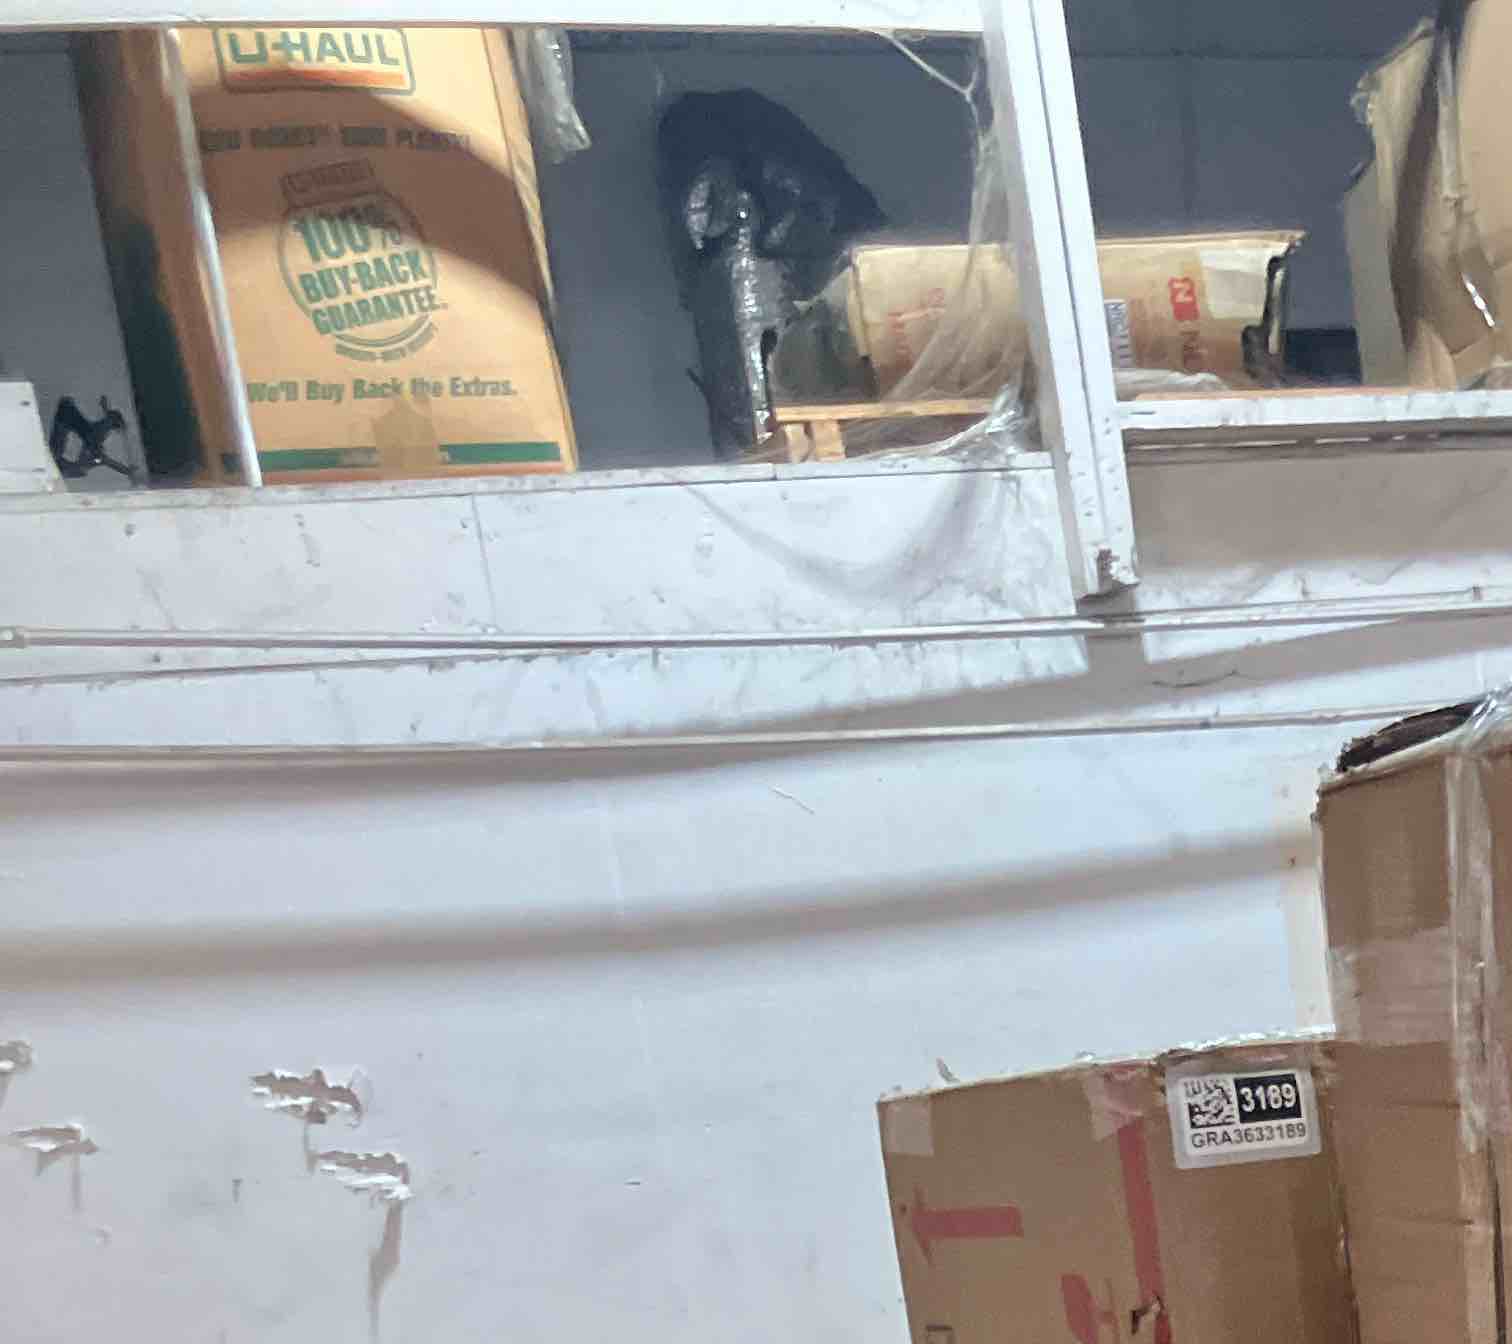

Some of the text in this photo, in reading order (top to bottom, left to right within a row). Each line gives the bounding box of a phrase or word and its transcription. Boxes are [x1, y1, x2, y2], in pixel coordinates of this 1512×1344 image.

[226, 30, 400, 66] U-HAUL
[299, 251, 432, 303] BUY-BACK
[304, 380, 346, 405] Buy
[352, 378, 405, 400] Back
[449, 376, 519, 399] Extras.
[1190, 1122, 1307, 1149] GRA3633189
